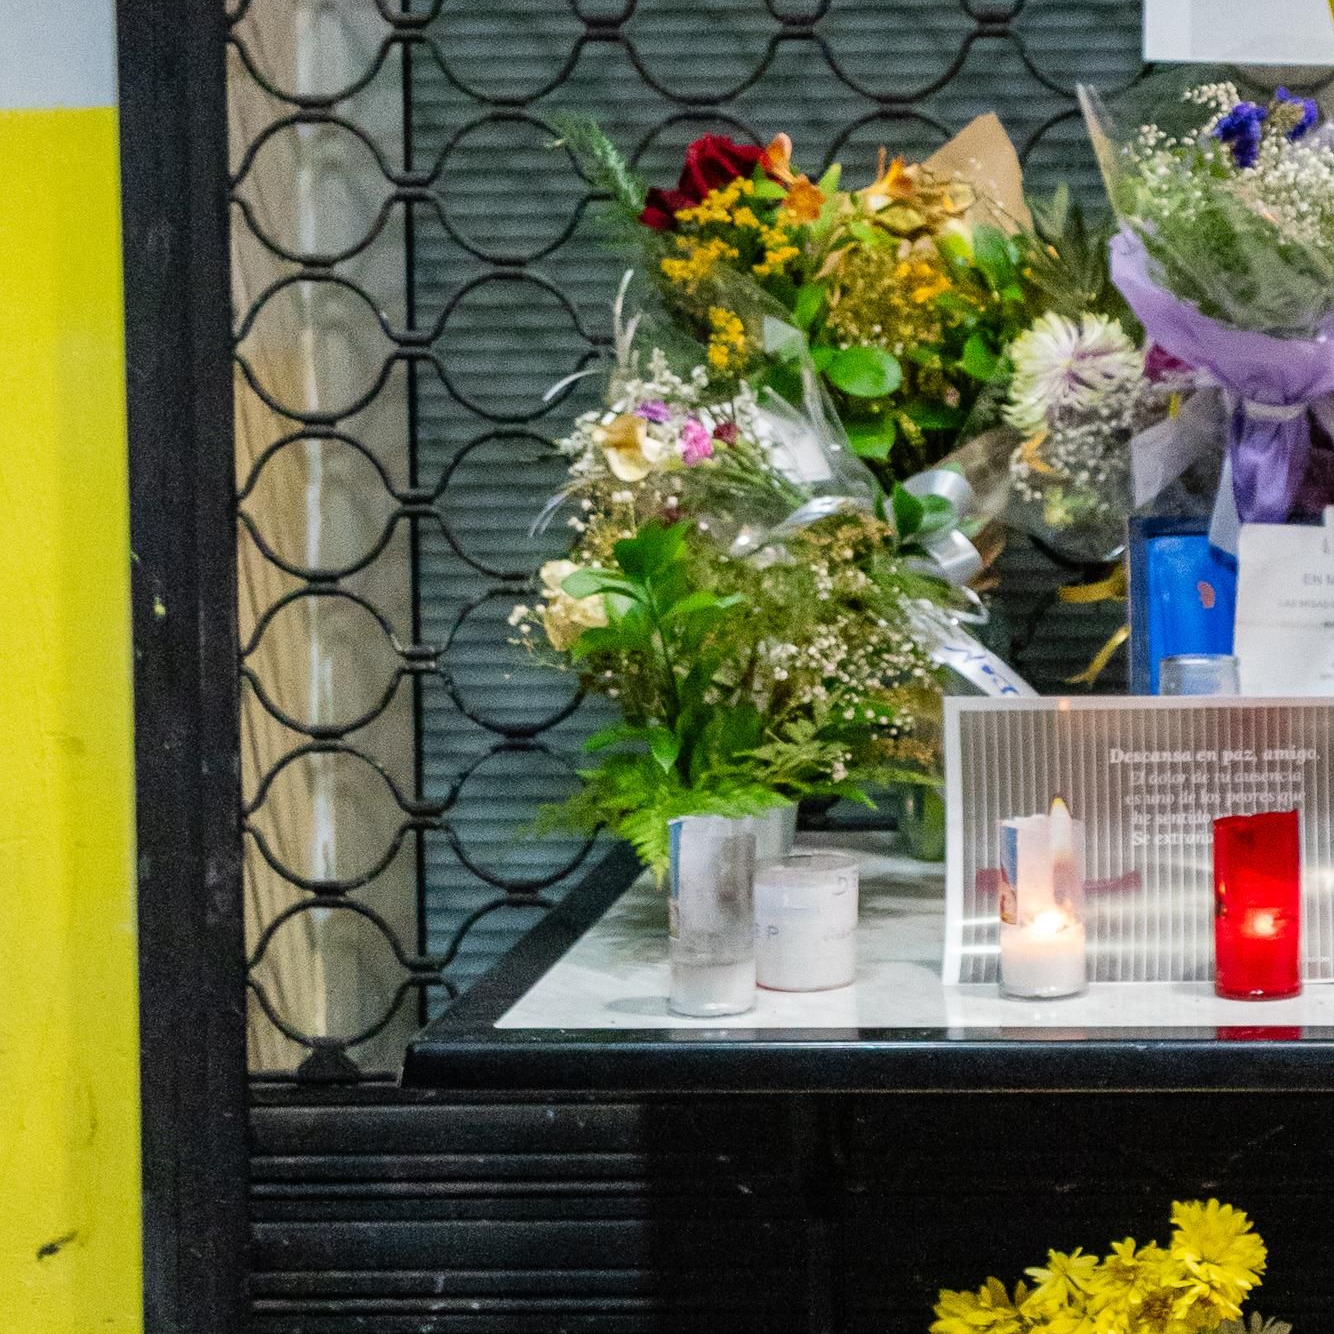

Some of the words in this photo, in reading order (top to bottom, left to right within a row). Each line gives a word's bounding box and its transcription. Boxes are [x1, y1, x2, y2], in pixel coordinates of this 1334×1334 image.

[1110, 748, 1192, 764] Descansa
[1195, 751, 1218, 763] en
[1221, 749, 1258, 766] paz,
[1263, 745, 1321, 767] amigo.
[1149, 770, 1186, 785] dolor
[1190, 769, 1210, 784] de
[1213, 771, 1231, 784] tu
[1234, 770, 1303, 784] ausencia
[1125, 793, 1142, 805] es
[1145, 793, 1176, 805] uno
[1178, 789, 1197, 804] de
[1200, 788, 1221, 804] los
[1225, 792, 1276, 807] peores
[1277, 791, 1306, 805] que
[1155, 811, 1212, 825] sentido
[1131, 831, 1152, 846] Se
